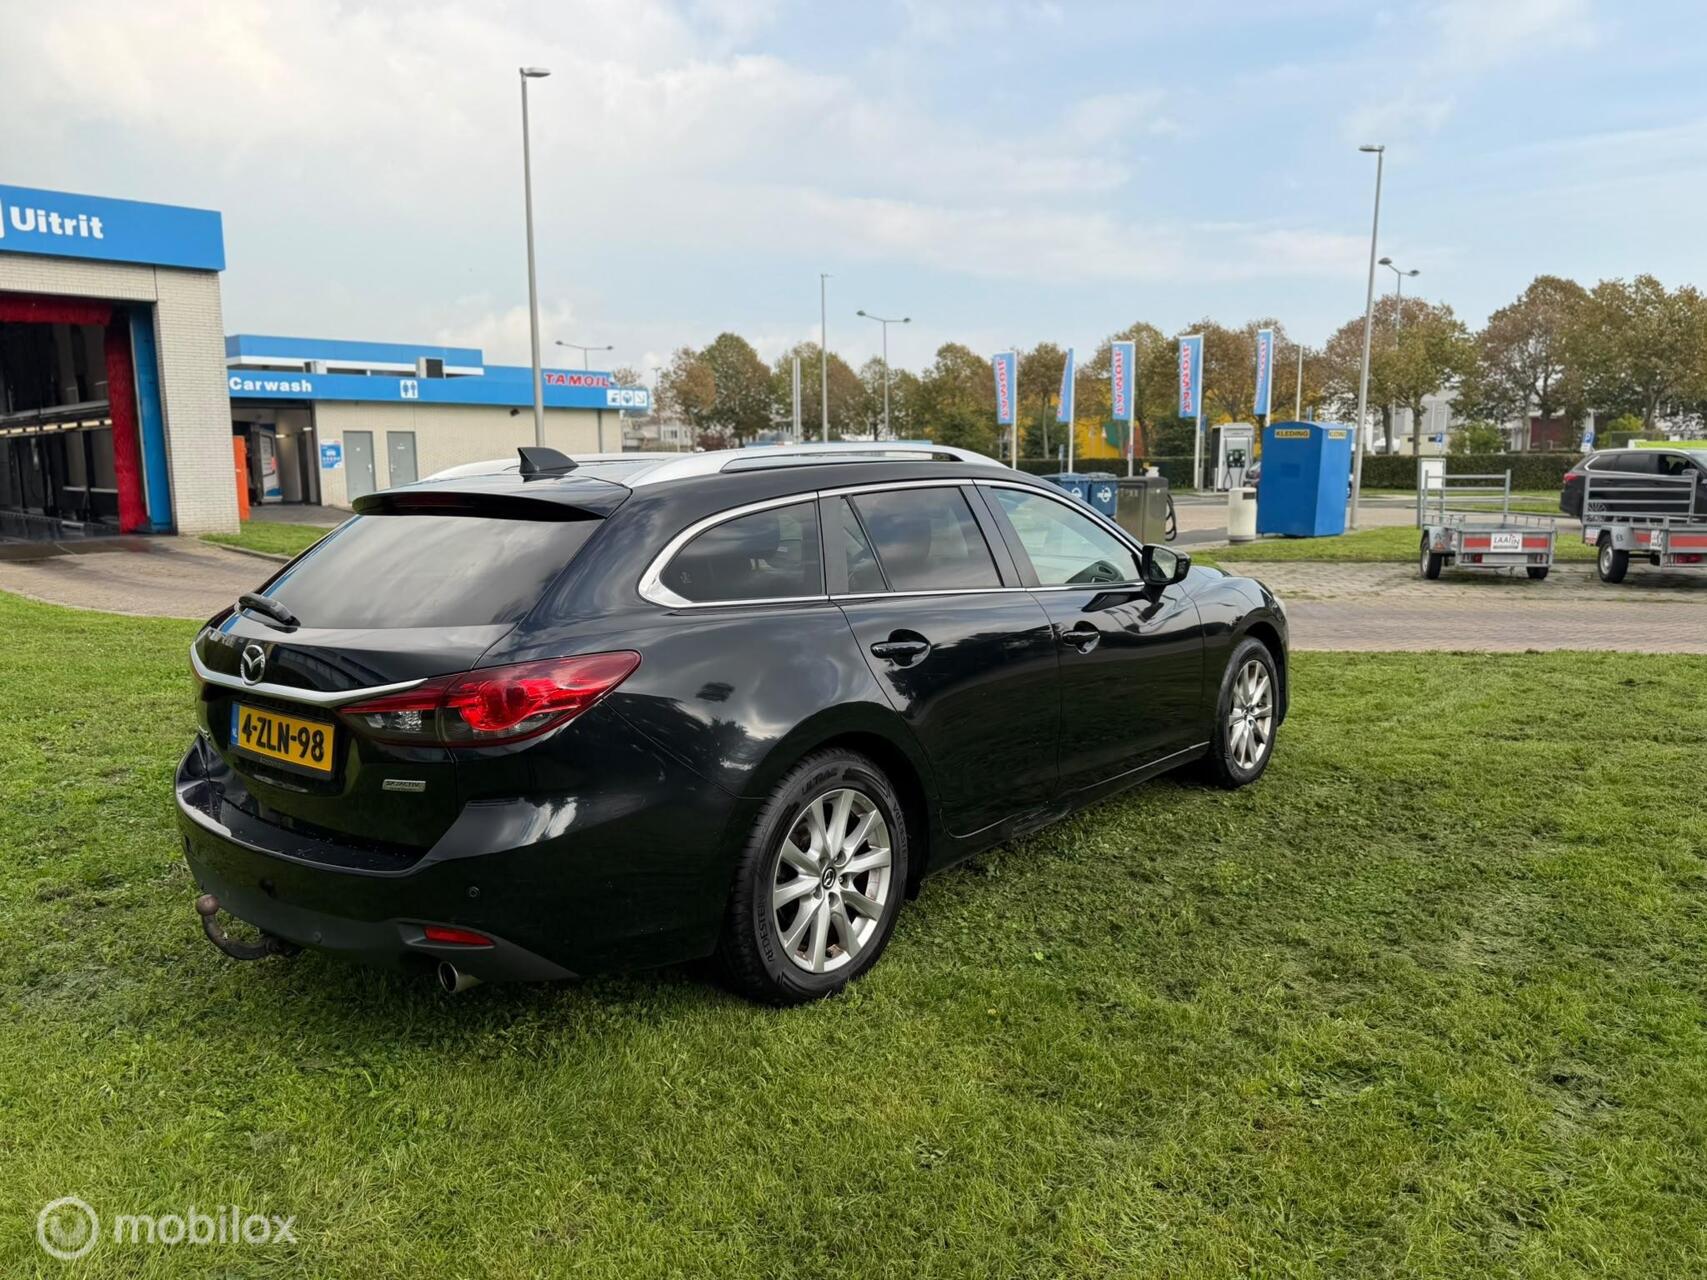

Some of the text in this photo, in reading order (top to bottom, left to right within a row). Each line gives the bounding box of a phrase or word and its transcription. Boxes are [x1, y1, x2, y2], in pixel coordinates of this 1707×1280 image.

[10, 206, 103, 239] Uitrit
[229, 376, 312, 393] Carwash
[544, 373, 610, 388] TAMOIL
[241, 713, 324, 763] 4-ZLN-98
